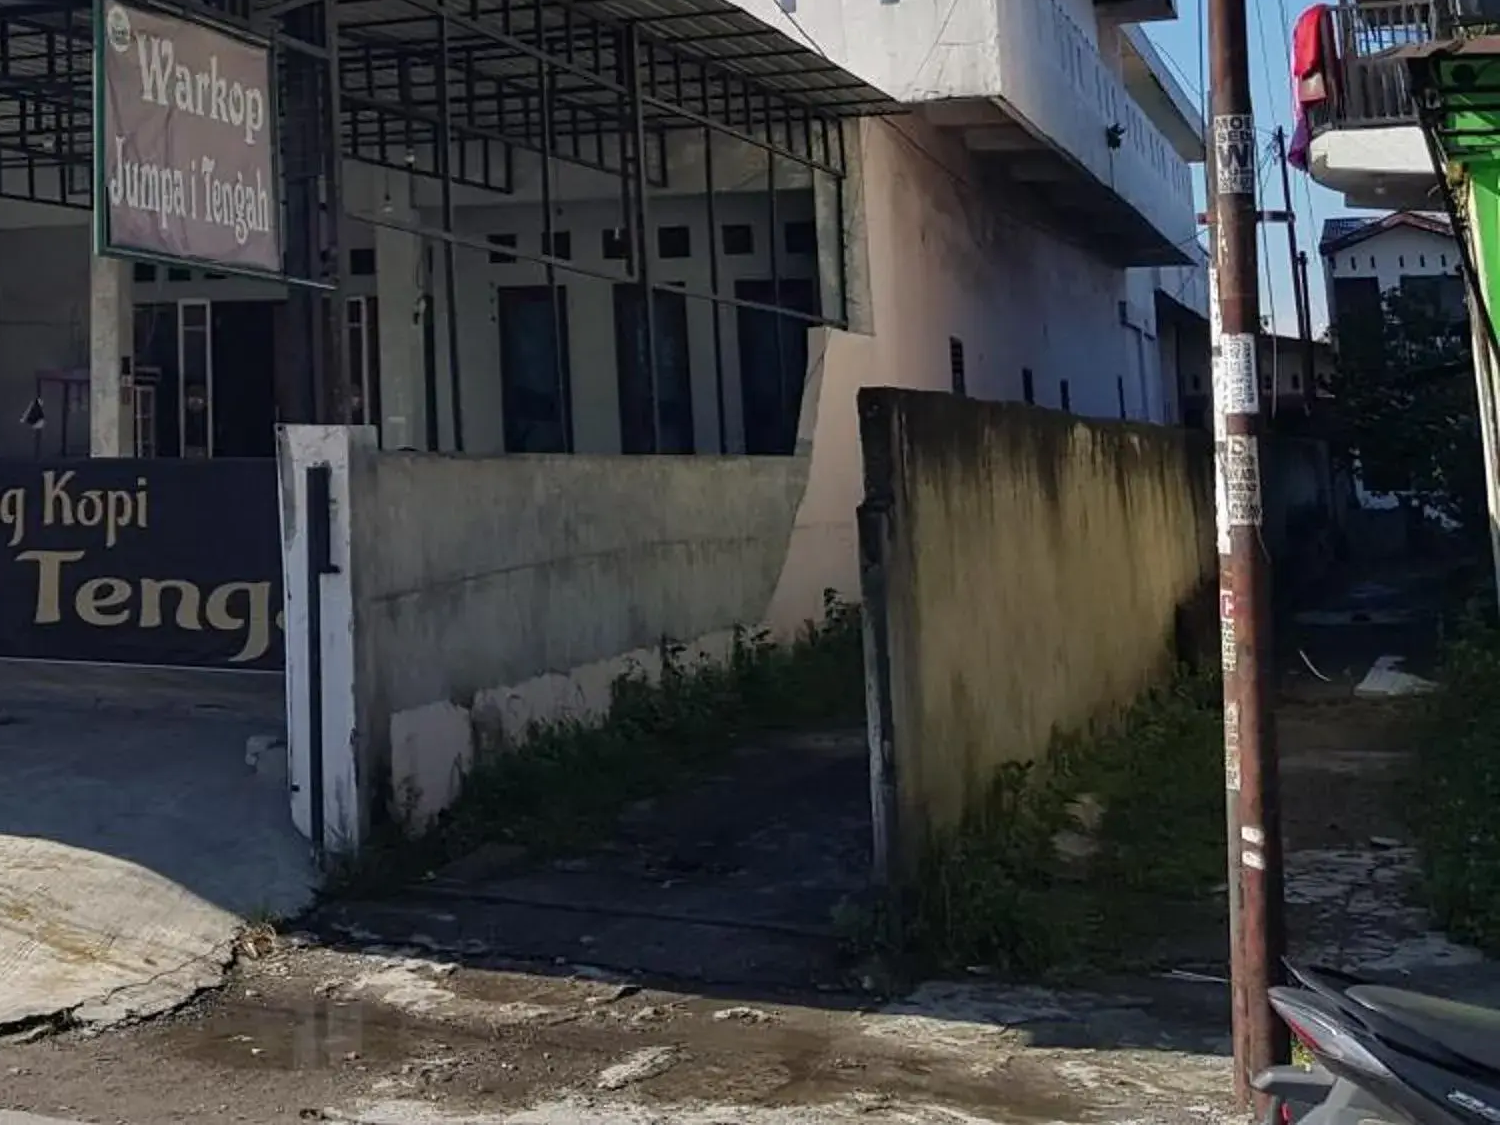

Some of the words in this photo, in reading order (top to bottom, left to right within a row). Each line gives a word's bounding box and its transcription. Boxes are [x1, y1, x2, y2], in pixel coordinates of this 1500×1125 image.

[136, 33, 263, 145] Warkop
[110, 135, 185, 229] Jumpa
[189, 159, 198, 221] i
[202, 154, 270, 246] Tengah
[43, 470, 148, 549] Kopi
[16, 550, 286, 663] Teng
